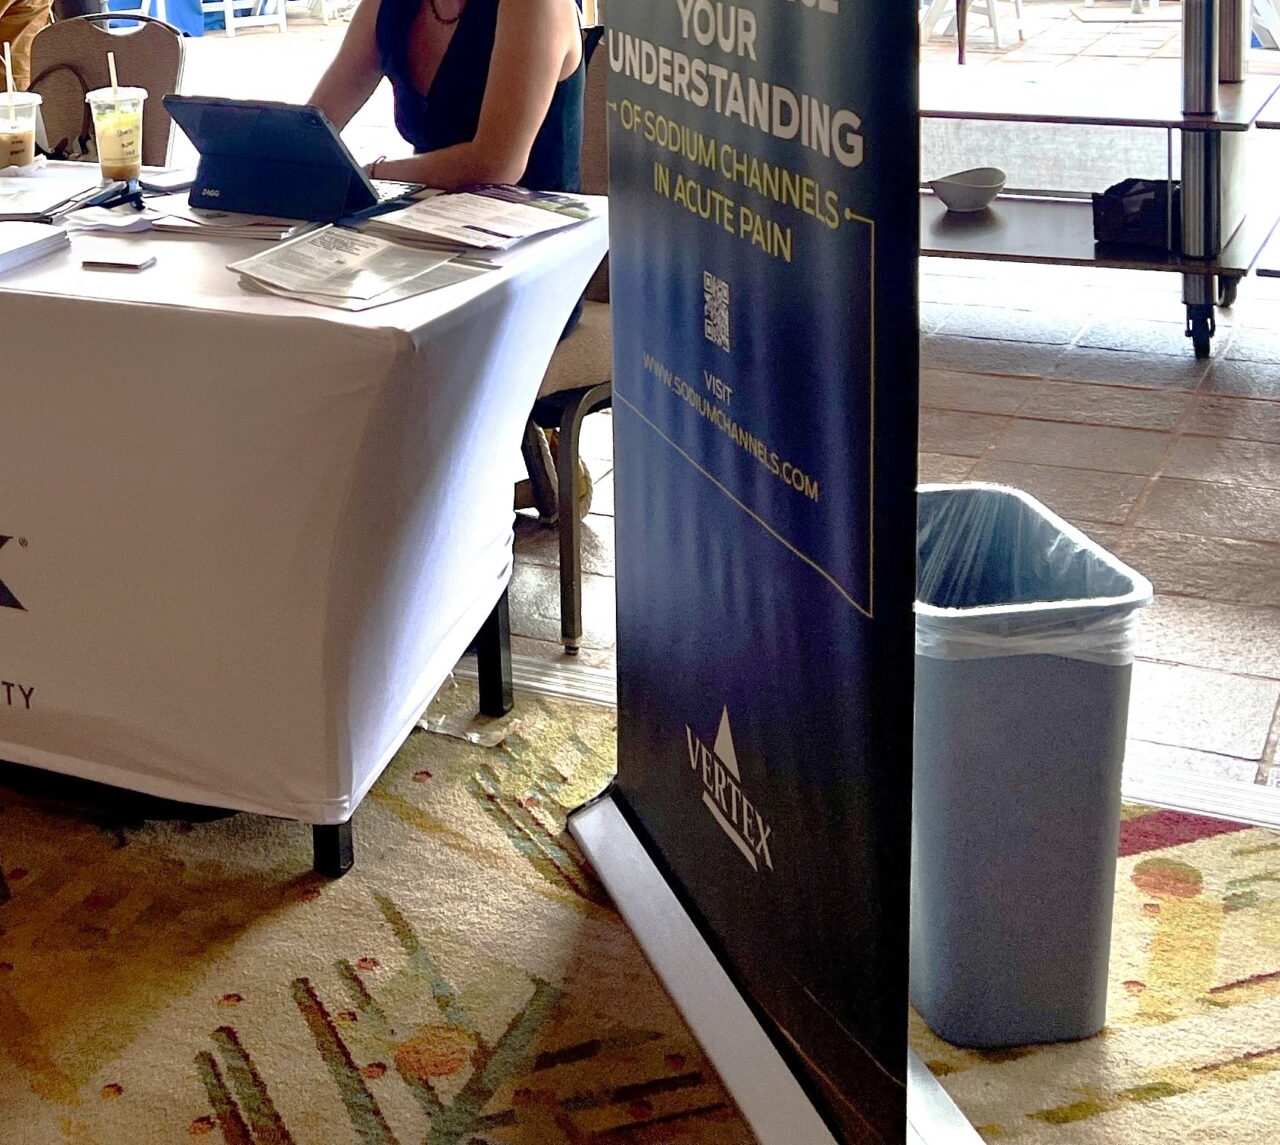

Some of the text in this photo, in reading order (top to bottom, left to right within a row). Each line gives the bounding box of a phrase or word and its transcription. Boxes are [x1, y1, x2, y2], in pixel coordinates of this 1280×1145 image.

[608, 29, 864, 168] UNDERSTANDING
[620, 100, 840, 230] OF SODIUM CHANNELS
[654, 161, 793, 262] IN ACUTE PAIN
[643, 351, 819, 502] WWW.SODIUMCHANNELS.COM
[704, 371, 733, 405] VISIT
[685, 723, 773, 871] VERTEX
